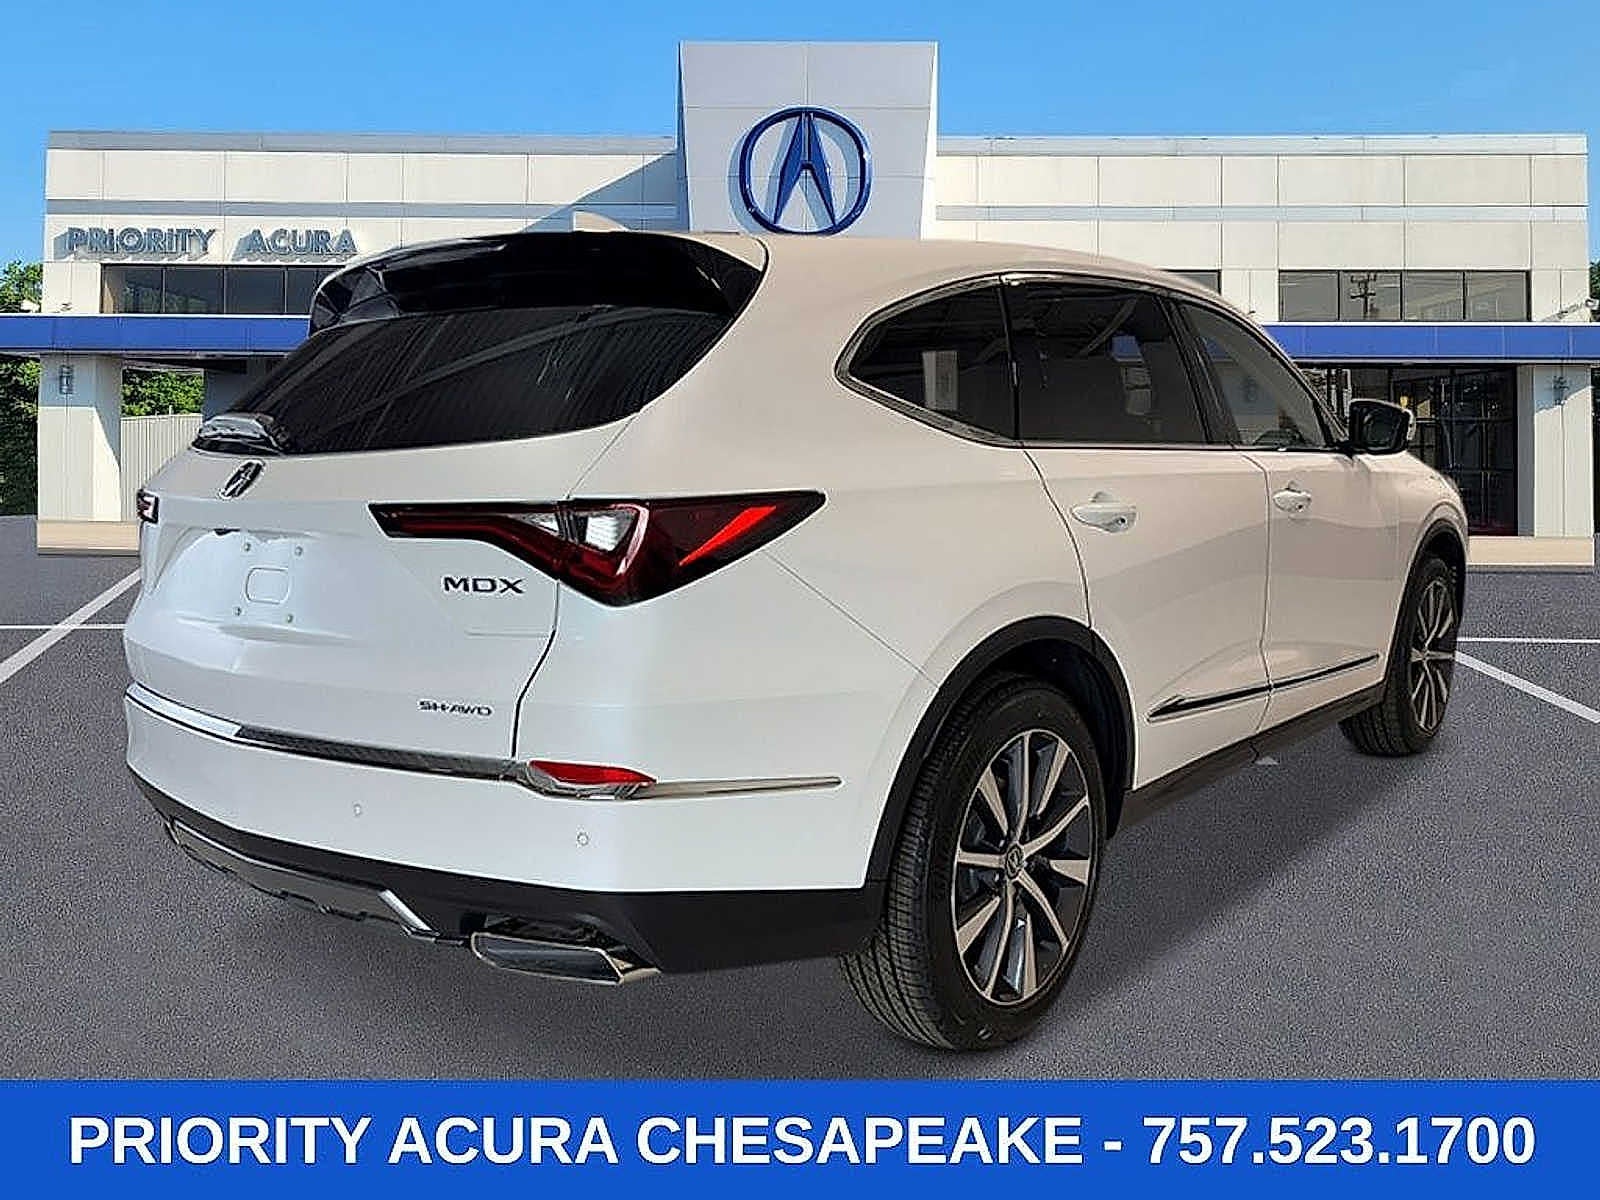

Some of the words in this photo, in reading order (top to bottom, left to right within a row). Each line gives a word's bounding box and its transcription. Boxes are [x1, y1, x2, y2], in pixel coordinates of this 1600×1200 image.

[67, 227, 216, 254] PRIORITY
[249, 228, 358, 254] ACURA
[443, 577, 524, 594] MDX
